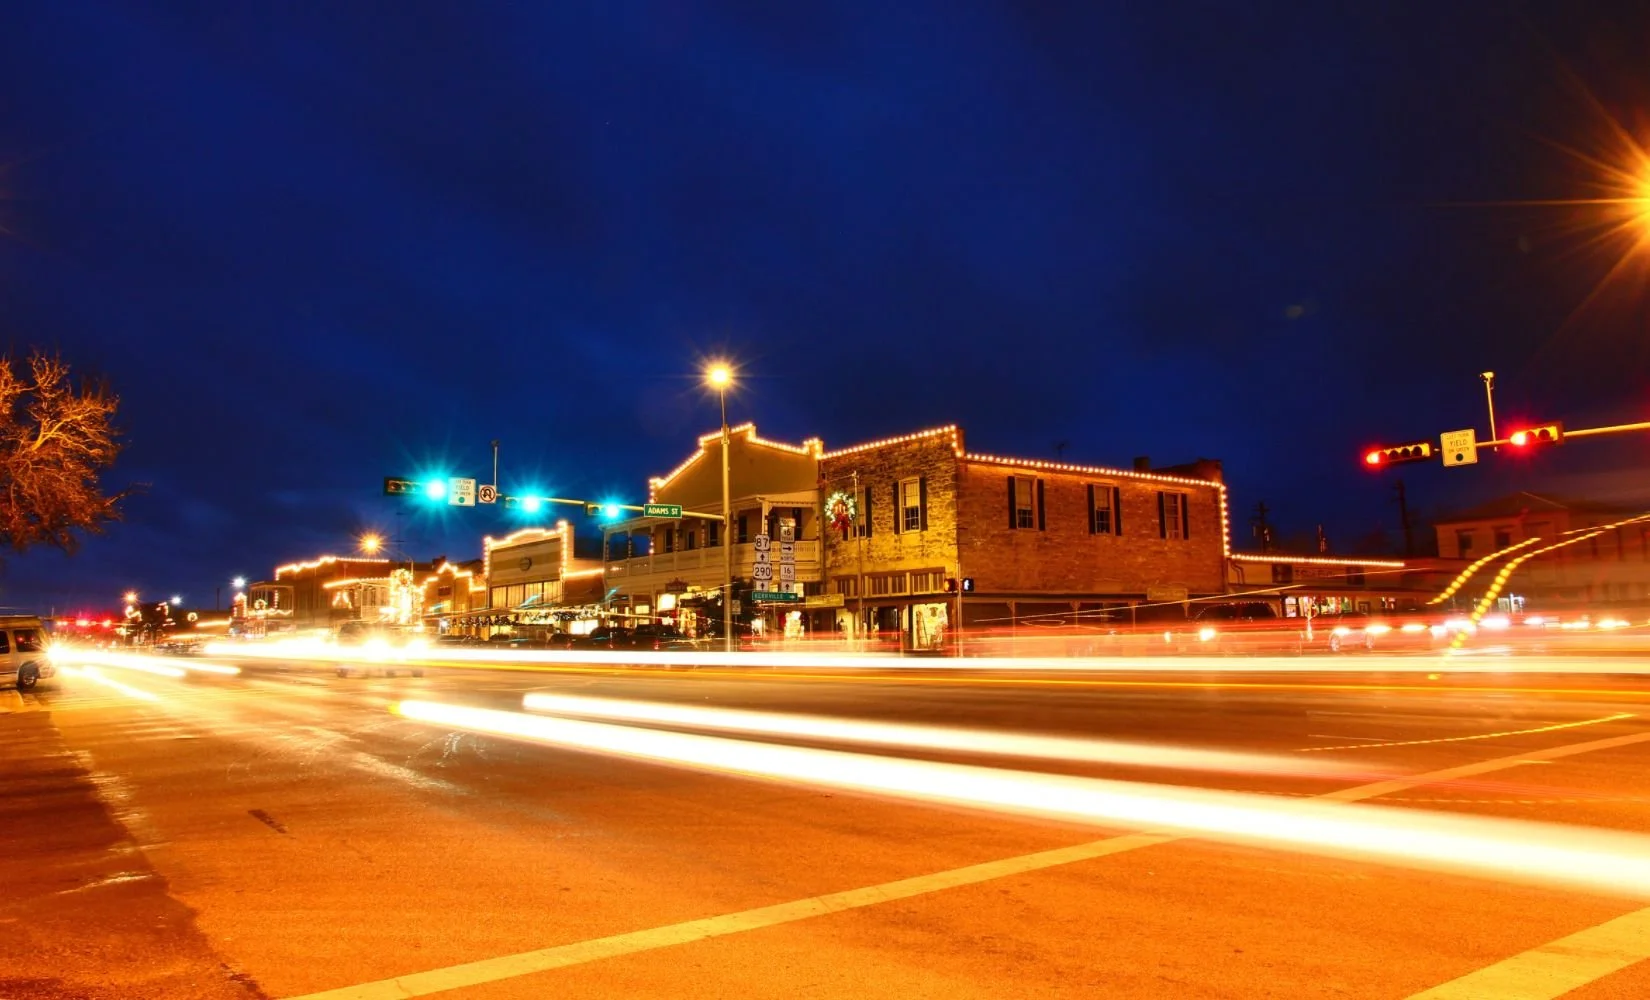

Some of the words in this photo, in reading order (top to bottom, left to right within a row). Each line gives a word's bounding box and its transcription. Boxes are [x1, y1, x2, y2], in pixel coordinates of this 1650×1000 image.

[1449, 439, 1468, 447] YIELD
[648, 507, 669, 515] ADAMS
[756, 537, 769, 548] 87
[754, 567, 771, 577] 290
[784, 567, 792, 575] 16
